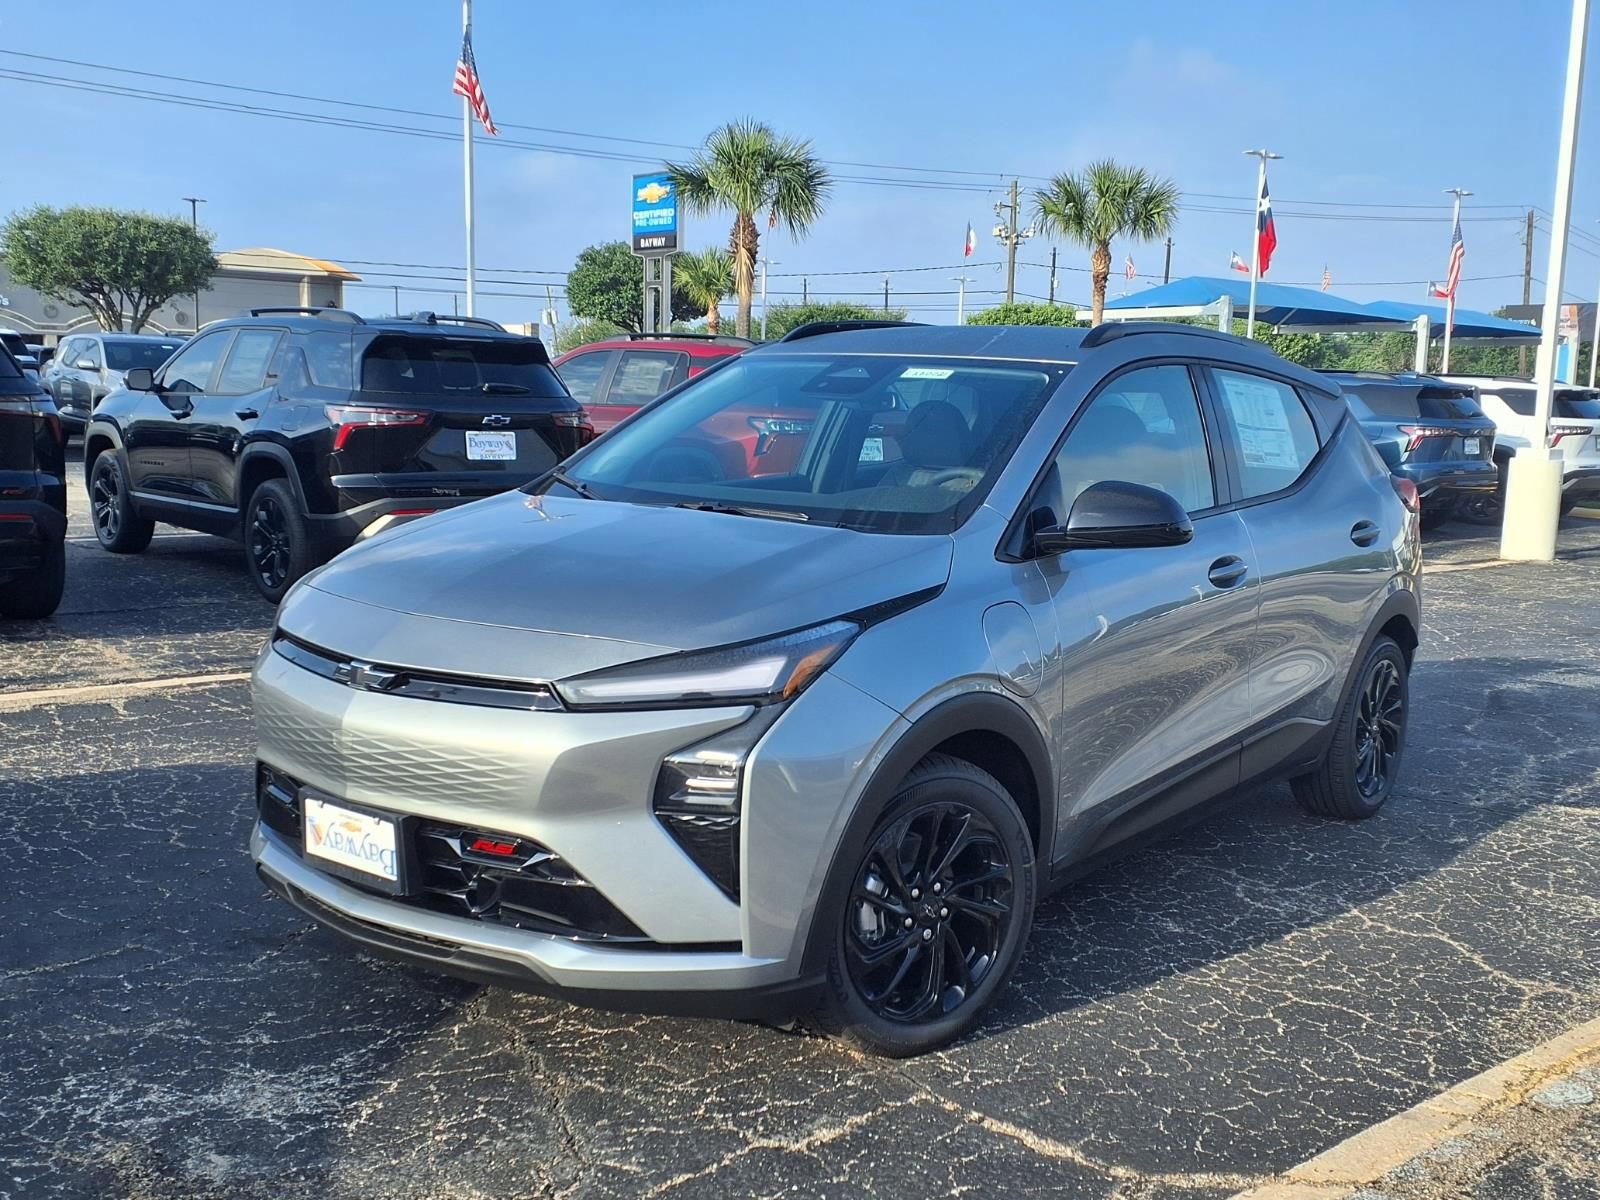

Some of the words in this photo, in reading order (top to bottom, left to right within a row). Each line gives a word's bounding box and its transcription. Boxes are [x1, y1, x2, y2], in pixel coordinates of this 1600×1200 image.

[633, 208, 675, 220] CERTIFIED
[635, 216, 673, 227] PRE-OWNED
[640, 236, 666, 248] BAYWAY
[469, 437, 504, 451] Bayway
[323, 822, 397, 876] Bayway
[472, 839, 514, 855] RS
